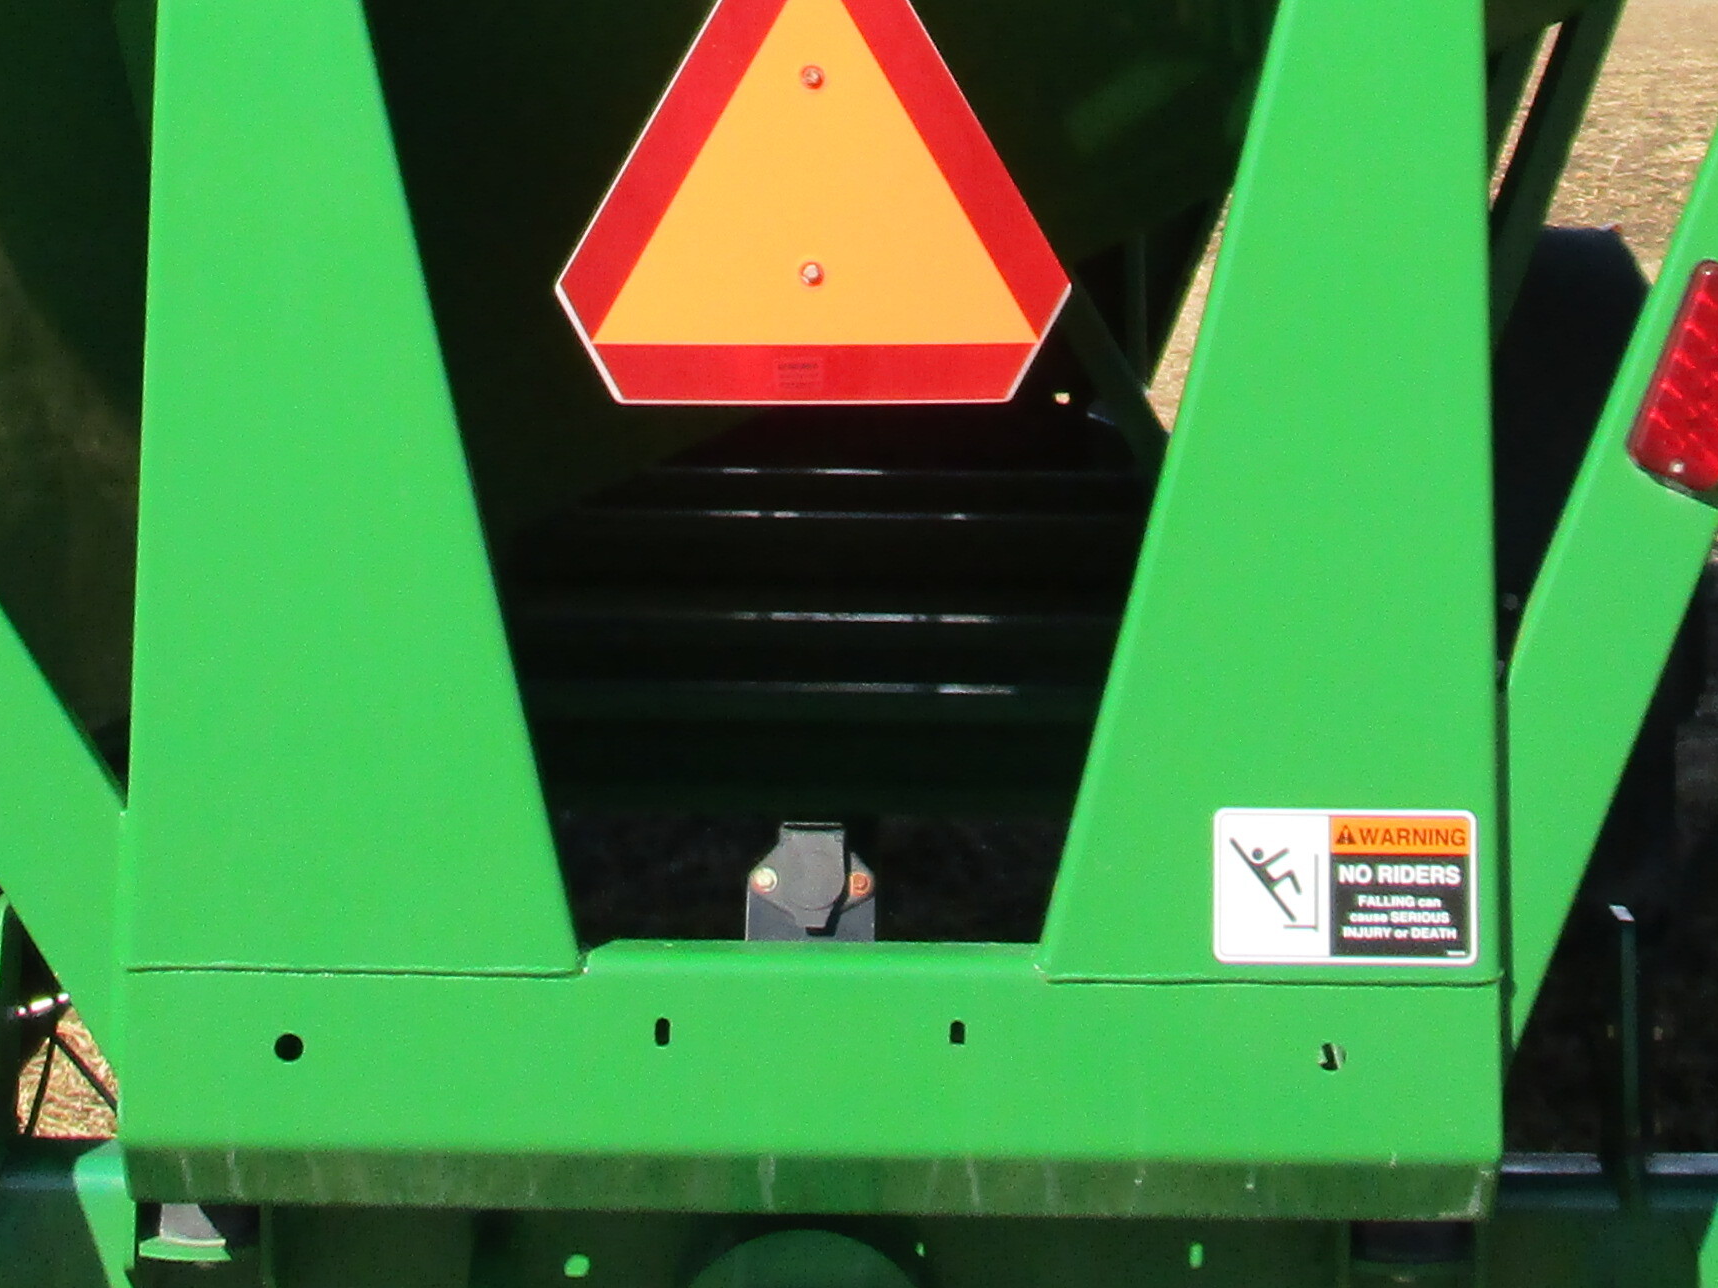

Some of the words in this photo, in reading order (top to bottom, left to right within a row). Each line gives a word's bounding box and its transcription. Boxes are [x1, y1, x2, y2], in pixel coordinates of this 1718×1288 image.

[1359, 828, 1467, 847] WARNING
[1338, 865, 1373, 885] NO
[1377, 865, 1462, 886] RIDERS
[1357, 895, 1415, 908] FALLING
[1417, 897, 1442, 908] can
[1349, 912, 1388, 924] cause
[1390, 911, 1451, 925] SERIOUS
[1342, 926, 1392, 940] INJURY
[1393, 929, 1410, 940] or
[1410, 927, 1458, 940] DEATH
